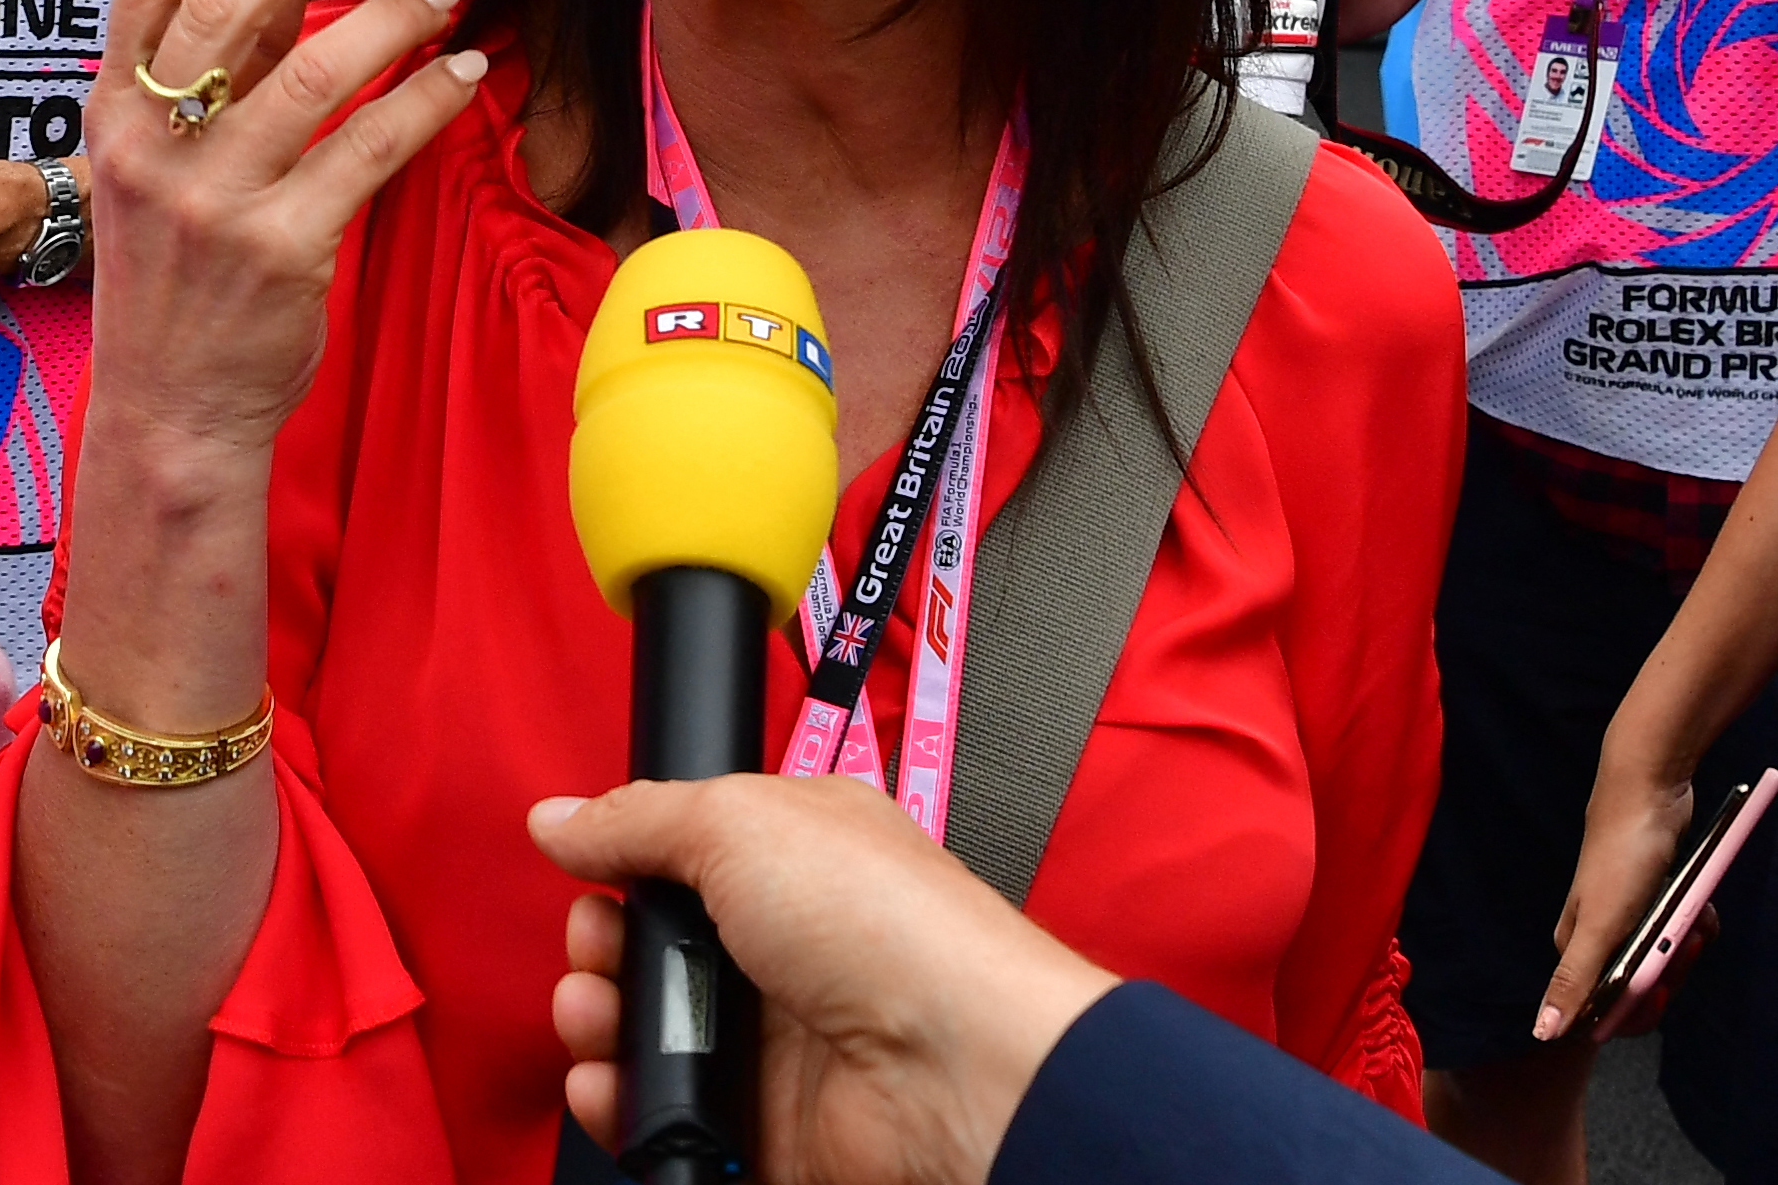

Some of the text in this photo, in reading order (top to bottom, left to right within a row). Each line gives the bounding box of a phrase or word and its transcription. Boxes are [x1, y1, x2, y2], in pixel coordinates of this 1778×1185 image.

[655, 309, 831, 378] RTL
[1588, 312, 1725, 347] ROLEX
[1563, 337, 1712, 380] GRAND
[1608, 379, 1674, 397] FORMULA
[1676, 387, 1706, 400] ONE
[1707, 387, 1759, 401] WORLD
[855, 502, 913, 605] Great
[894, 385, 956, 500] Britain
[941, 506, 953, 528] FIA
[934, 531, 961, 568] FIA
